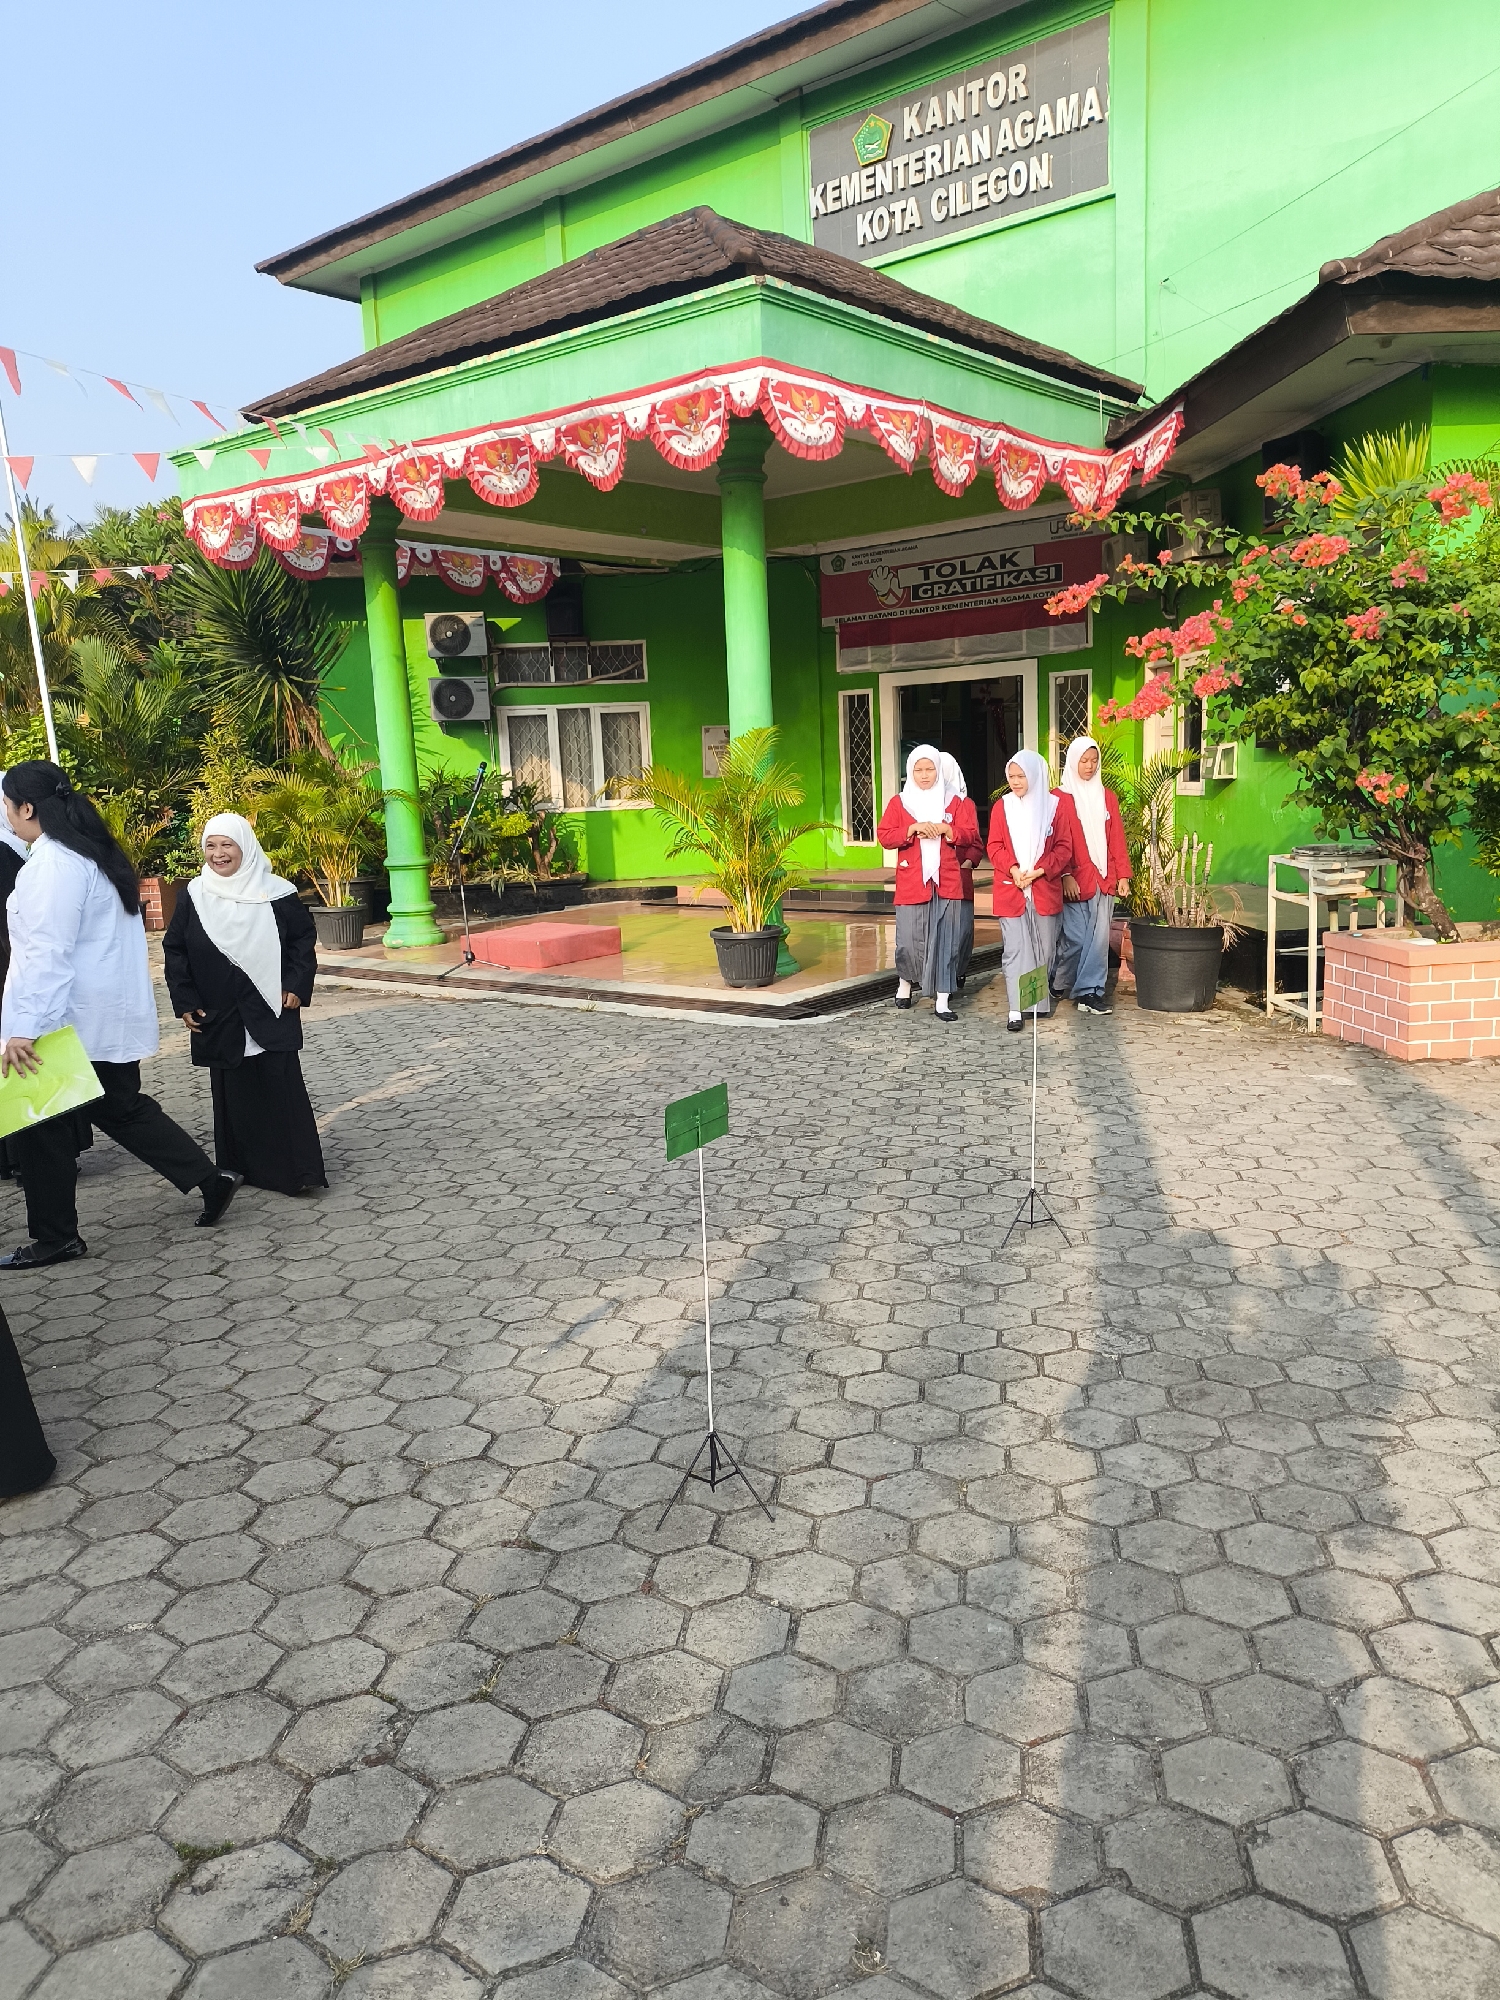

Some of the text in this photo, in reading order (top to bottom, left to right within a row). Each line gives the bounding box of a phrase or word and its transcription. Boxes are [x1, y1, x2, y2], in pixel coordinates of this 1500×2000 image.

[903, 63, 1029, 141] KANTOR
[809, 86, 1103, 219] KEMENTERIAN AGAMA
[857, 152, 1052, 246] KOTA CILEGON
[918, 551, 1020, 581] TOLAK
[918, 567, 1056, 598] GRATIFIKASI
[835, 614, 866, 623] SELAMAT
[869, 611, 897, 620] DATANG
[910, 606, 940, 615] KANTOR
[942, 598, 998, 610] KEMENTERIAN
[1001, 594, 1031, 603] AGAMA
[1033, 590, 1055, 599] KOTA
